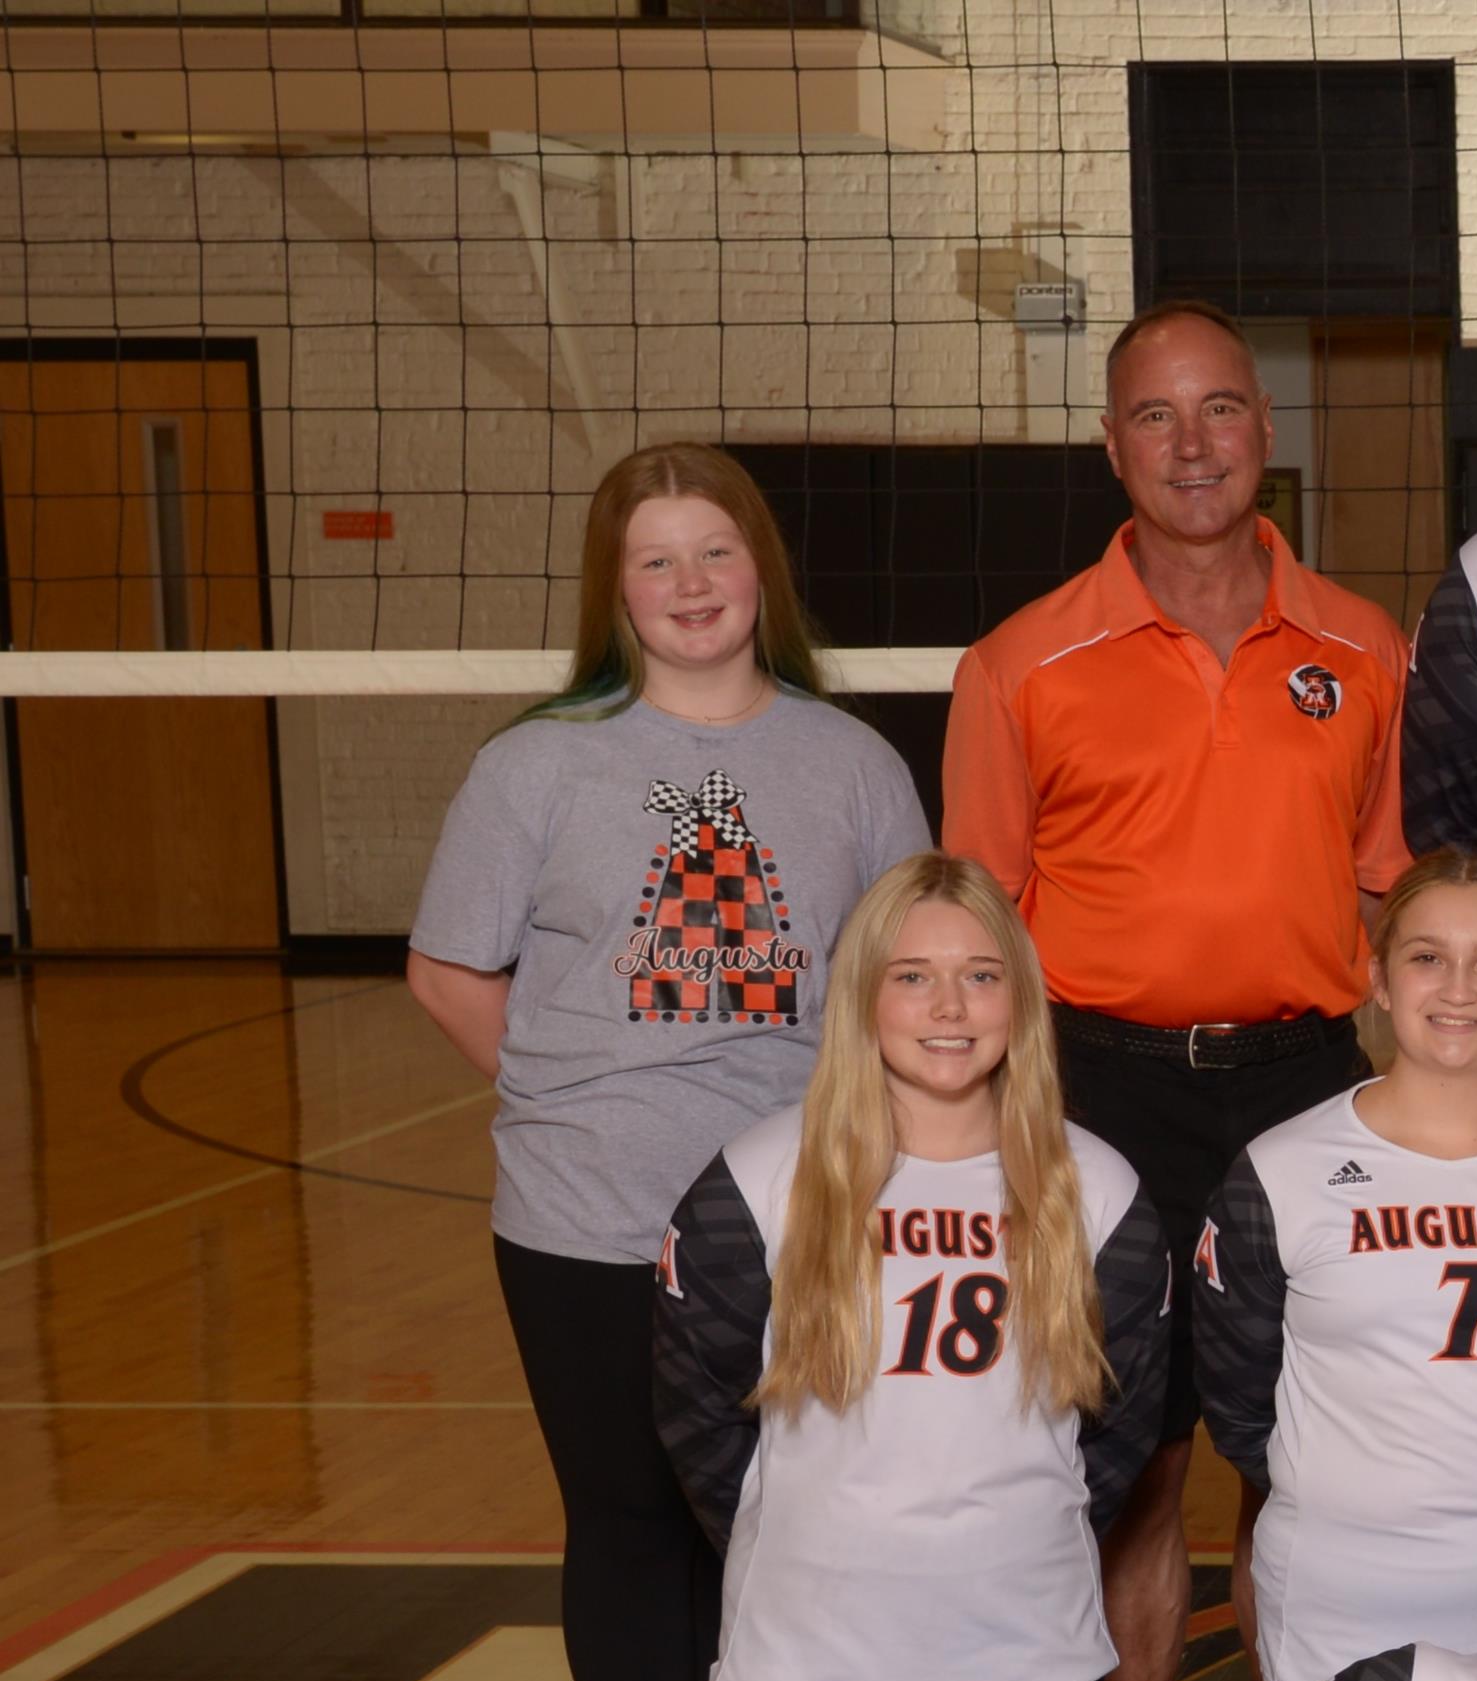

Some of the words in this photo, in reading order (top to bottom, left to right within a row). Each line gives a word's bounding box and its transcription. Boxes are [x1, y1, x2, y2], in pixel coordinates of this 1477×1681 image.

[613, 926, 809, 984] Augusta
[1328, 1173, 1373, 1186] adidas
[881, 1271, 1010, 1377] 18
